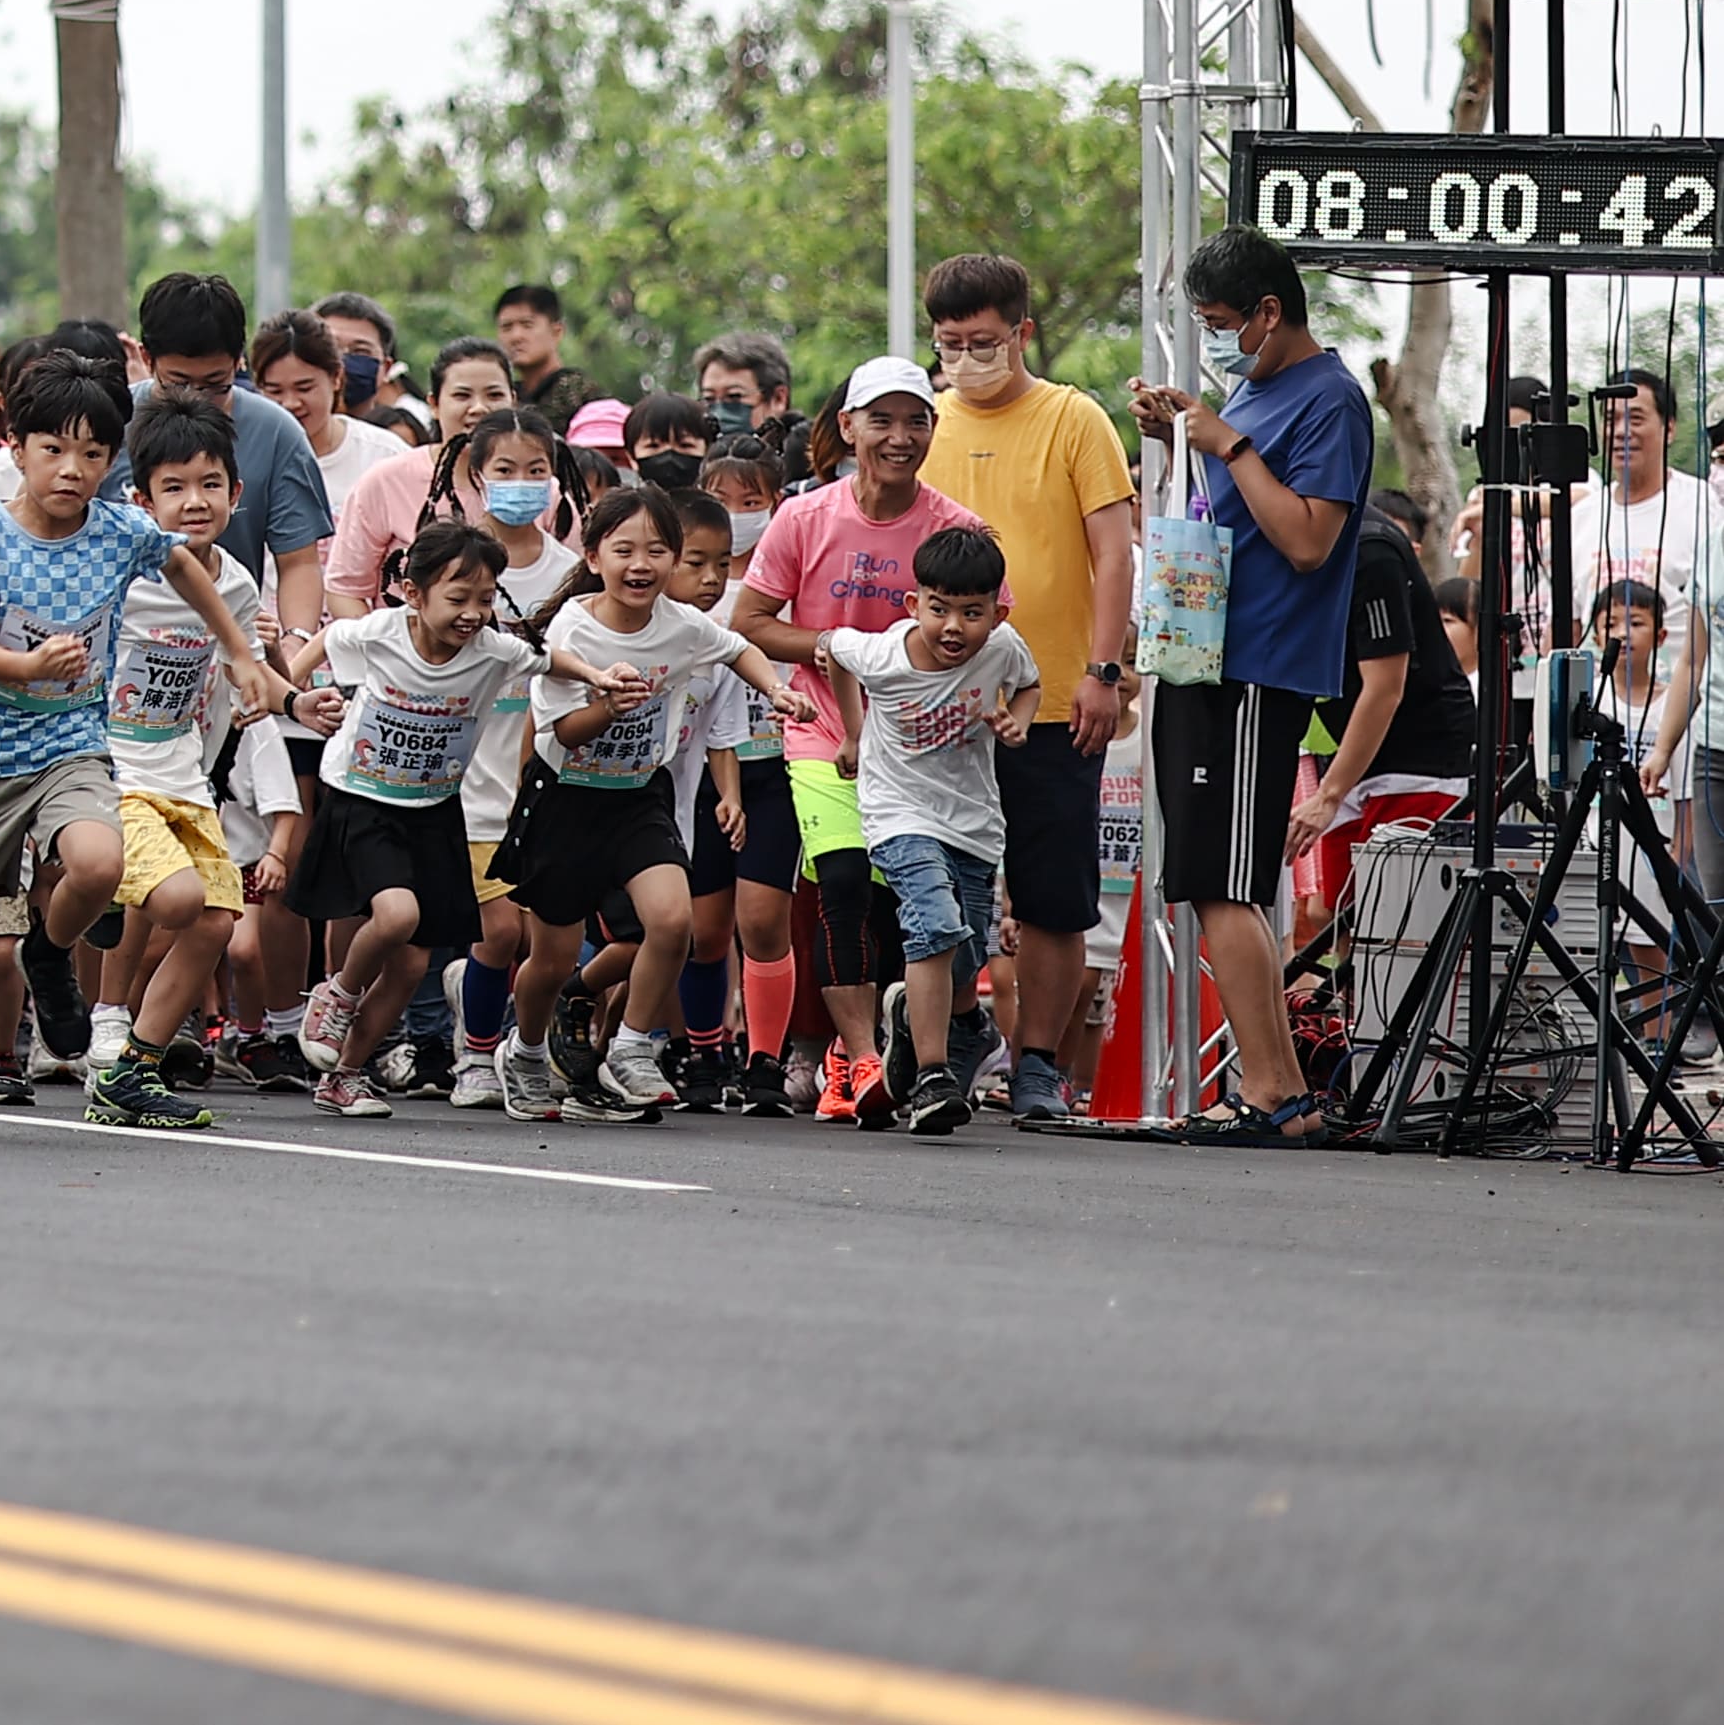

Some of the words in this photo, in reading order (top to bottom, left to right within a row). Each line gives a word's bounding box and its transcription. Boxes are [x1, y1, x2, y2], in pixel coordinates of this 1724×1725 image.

[1257, 167, 1716, 248] 08:00:42
[855, 553, 898, 573] Run
[830, 580, 905, 607] Chang
[378, 725, 448, 751] Y0684
